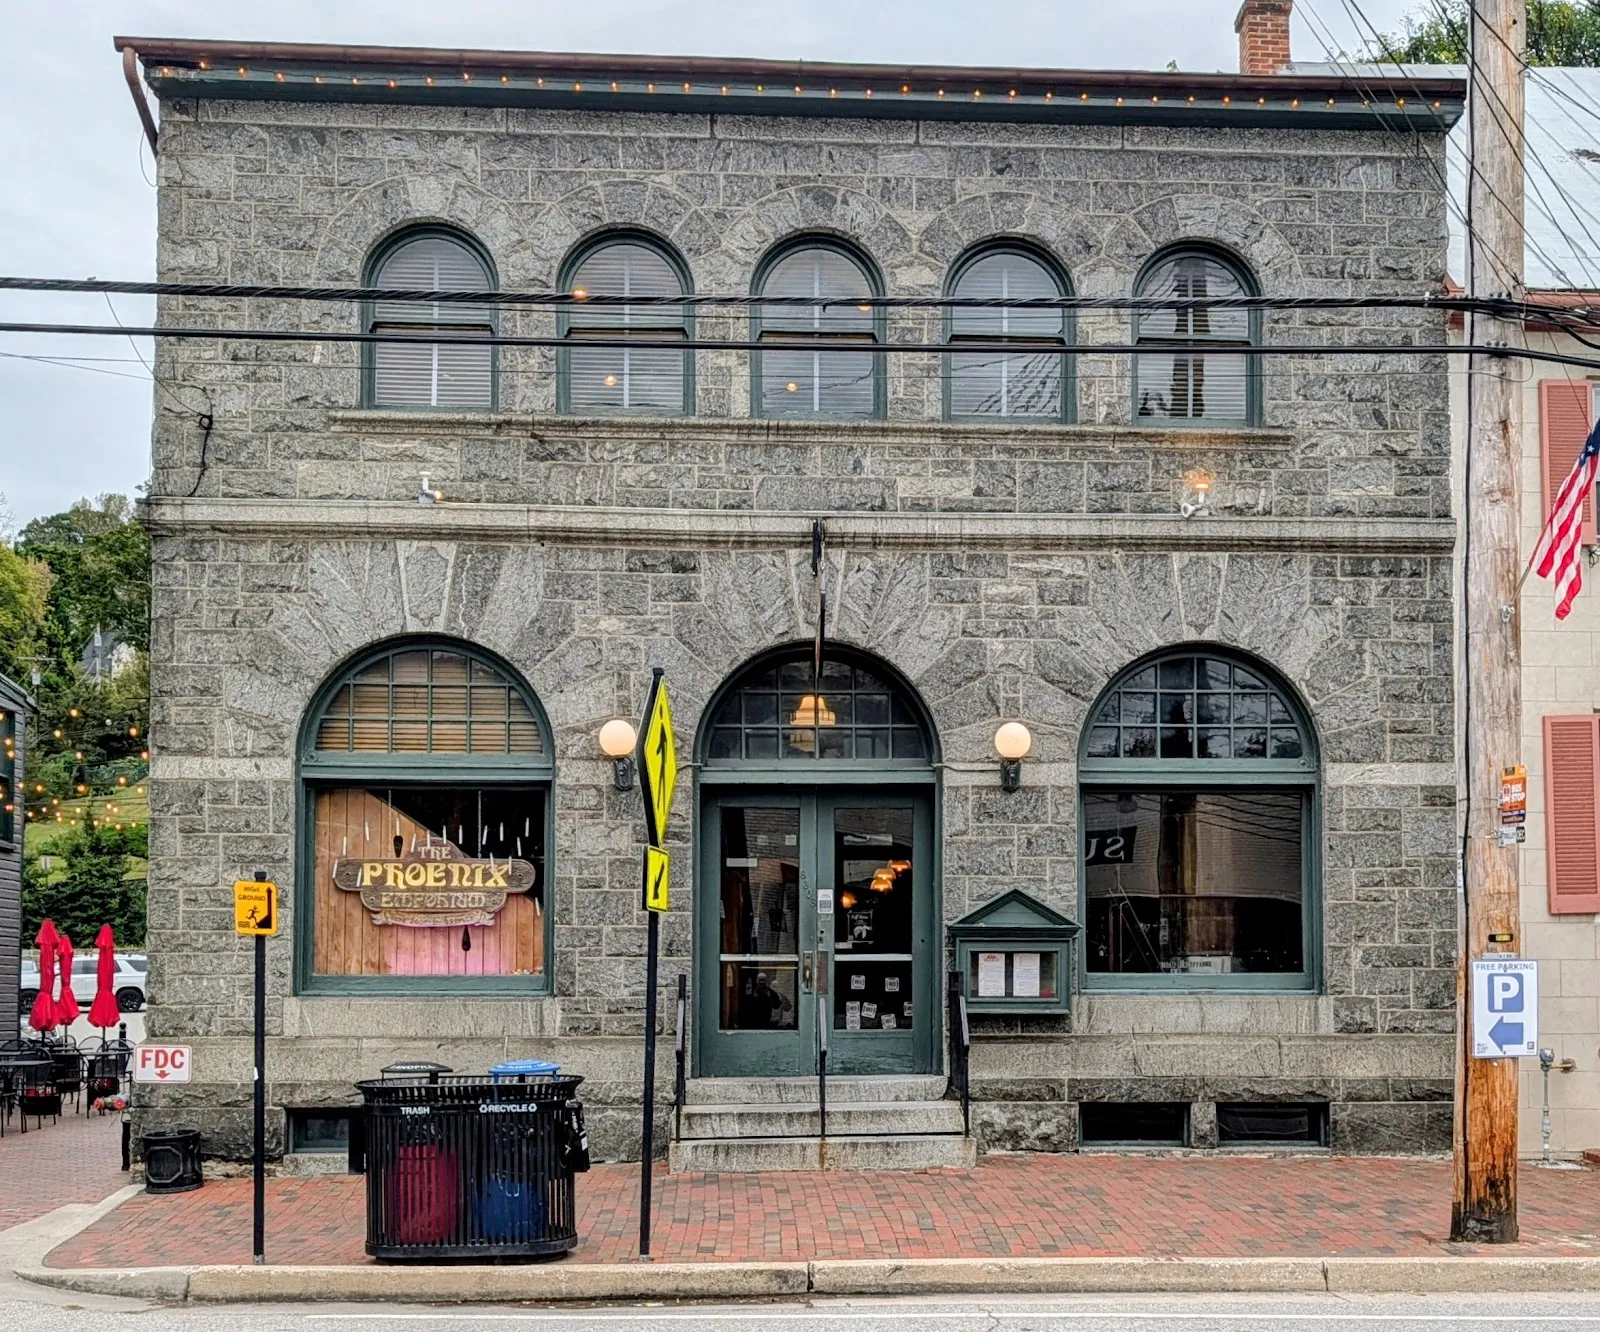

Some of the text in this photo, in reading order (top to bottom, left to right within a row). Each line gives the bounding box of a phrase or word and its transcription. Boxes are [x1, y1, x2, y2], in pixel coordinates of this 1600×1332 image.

[1511, 792, 1525, 803] STOP
[418, 846, 451, 860] THE
[361, 862, 510, 889] PHOENIX
[237, 894, 266, 902] GROUND
[381, 891, 486, 908] EMPORIUM
[1475, 963, 1535, 971] FREE PARKING
[1493, 975, 1520, 1011] P
[140, 1048, 185, 1069] FDC
[400, 1106, 430, 1115] TRASH
[488, 1104, 528, 1113] RECYCLE
